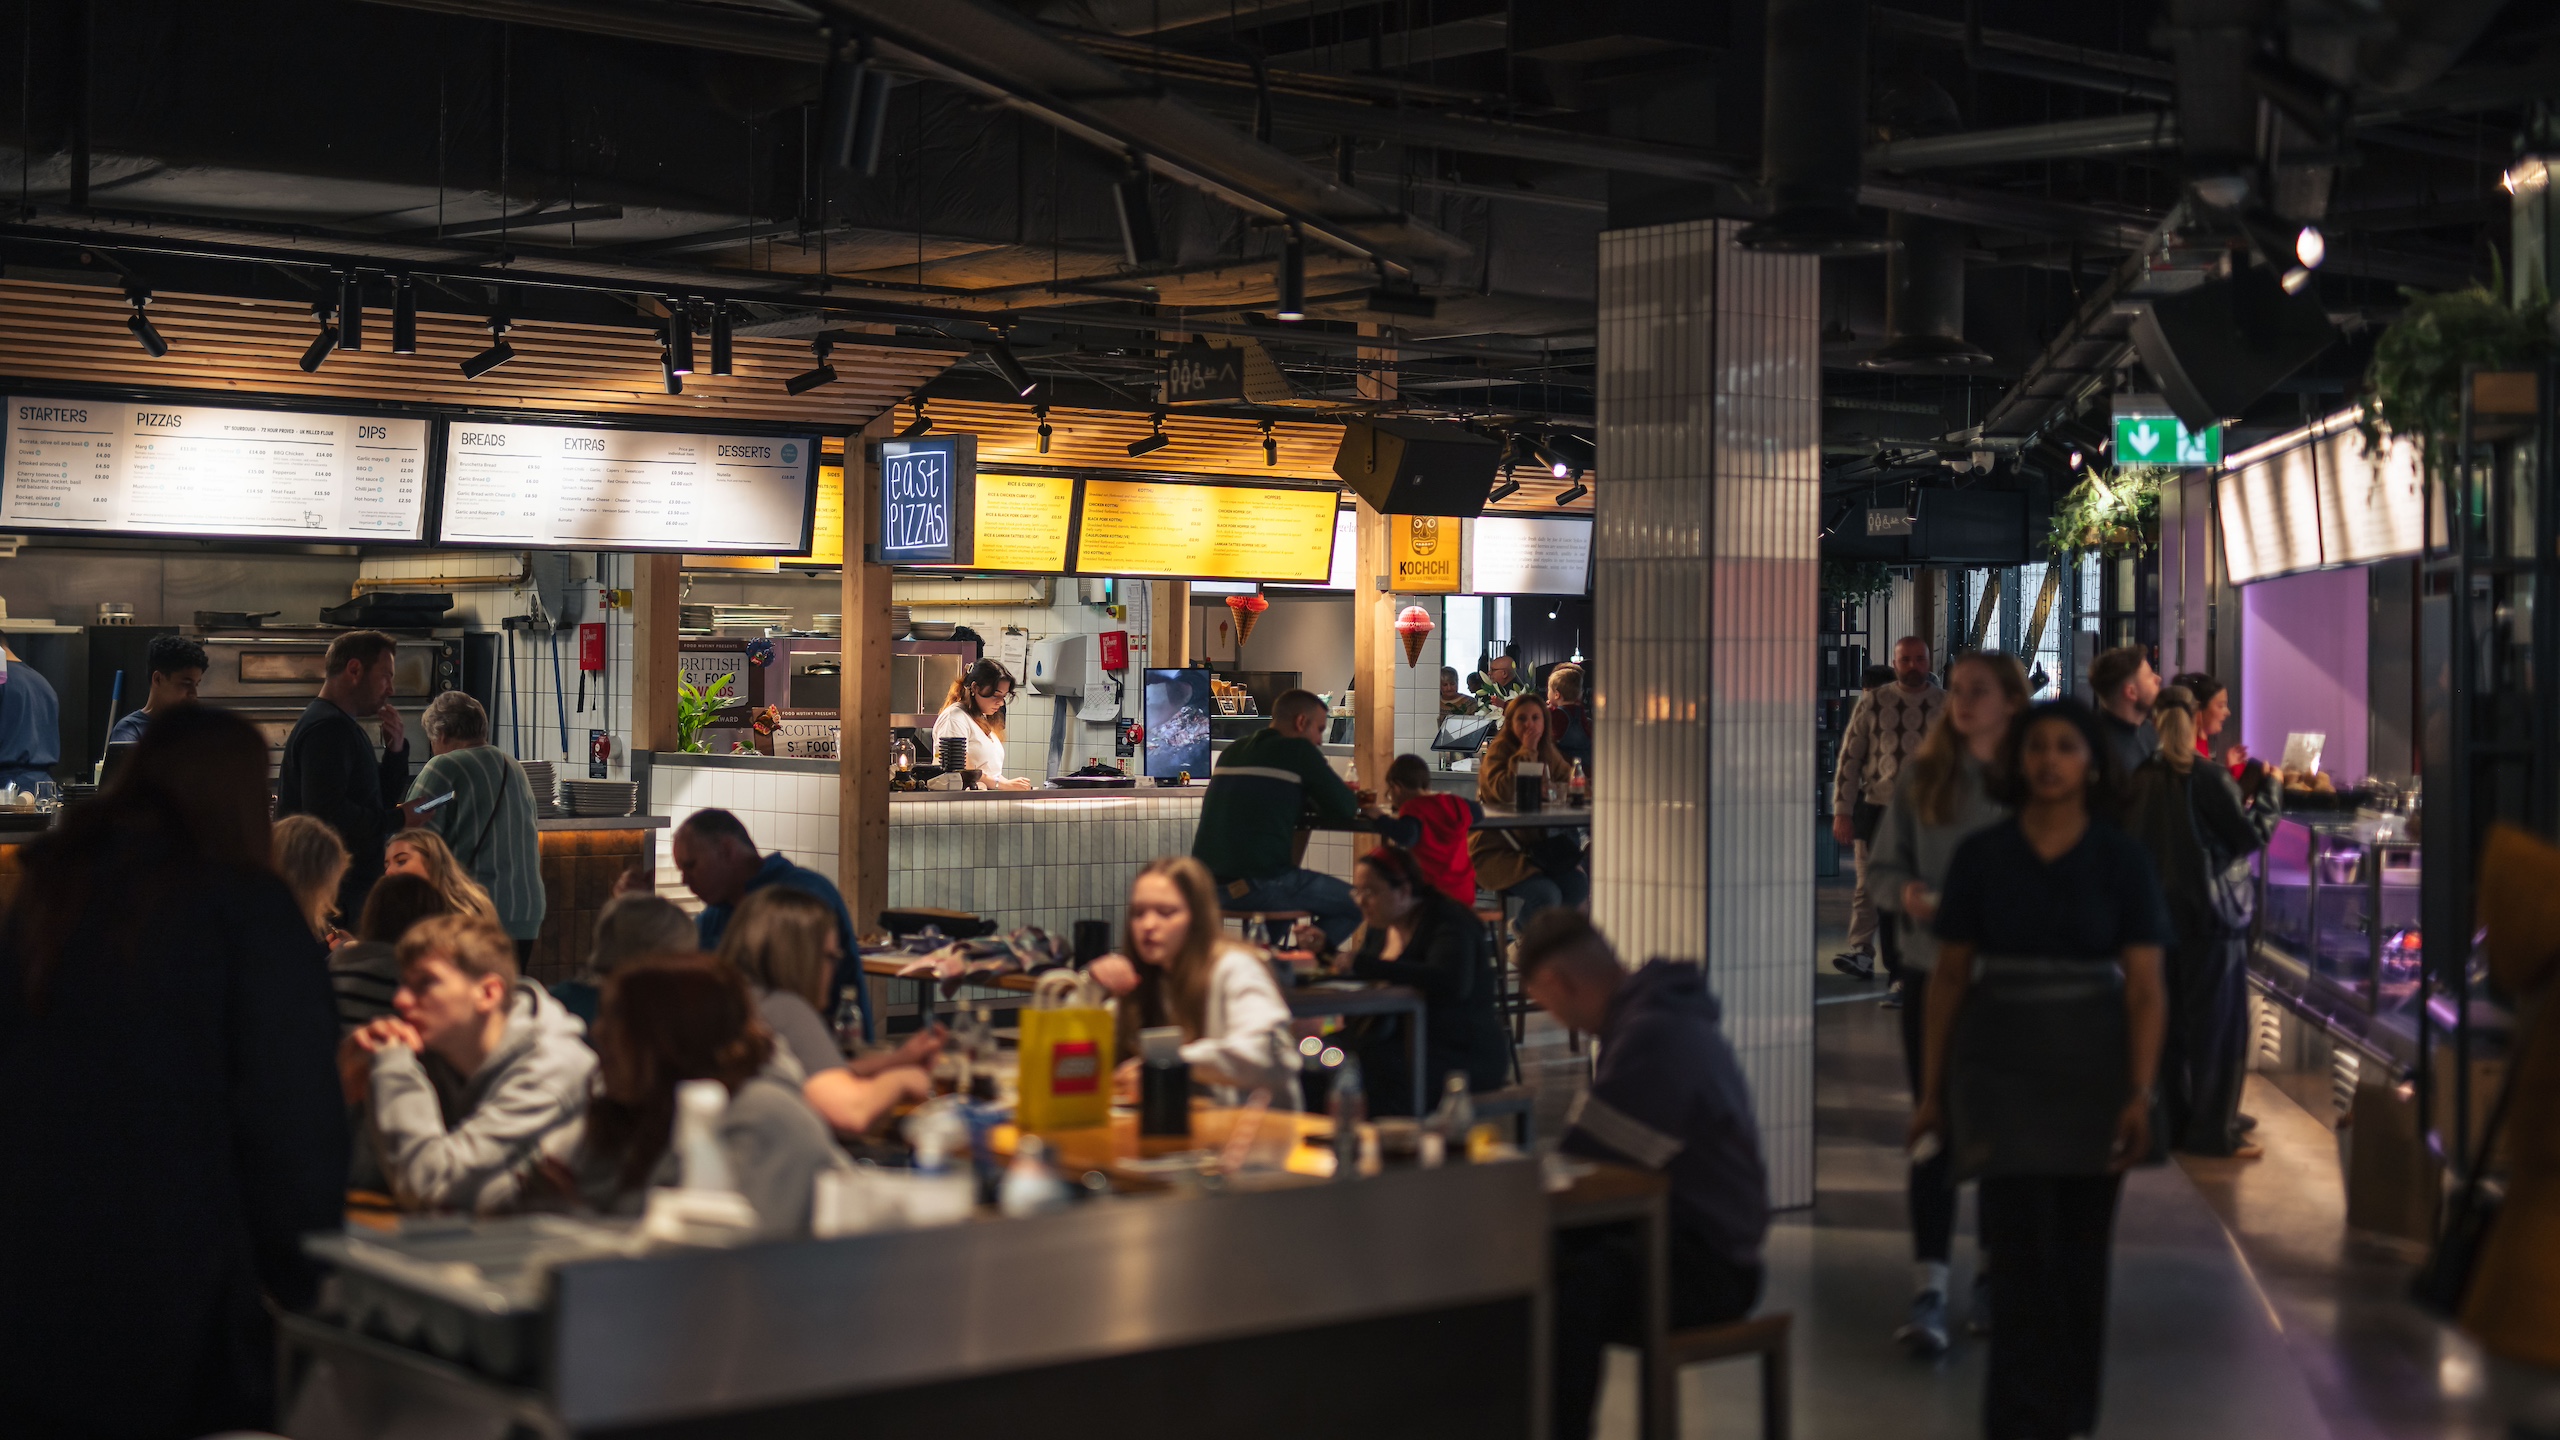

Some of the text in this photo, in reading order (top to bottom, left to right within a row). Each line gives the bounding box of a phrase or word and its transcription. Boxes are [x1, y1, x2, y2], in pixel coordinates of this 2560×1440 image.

[20, 406, 88, 423] STARTERS
[136, 412, 182, 428] PIZZAS
[358, 425, 387, 440] DIPS
[461, 432, 506, 447] BREADS
[564, 437, 606, 452] EXTRAS
[717, 444, 771, 459] DESSERTS
[891, 458, 940, 501] east
[890, 503, 945, 547] PIZZAS
[1400, 560, 1450, 576] KOCHCHI
[680, 657, 741, 672] BRITISH
[806, 741, 837, 753] FOOD
